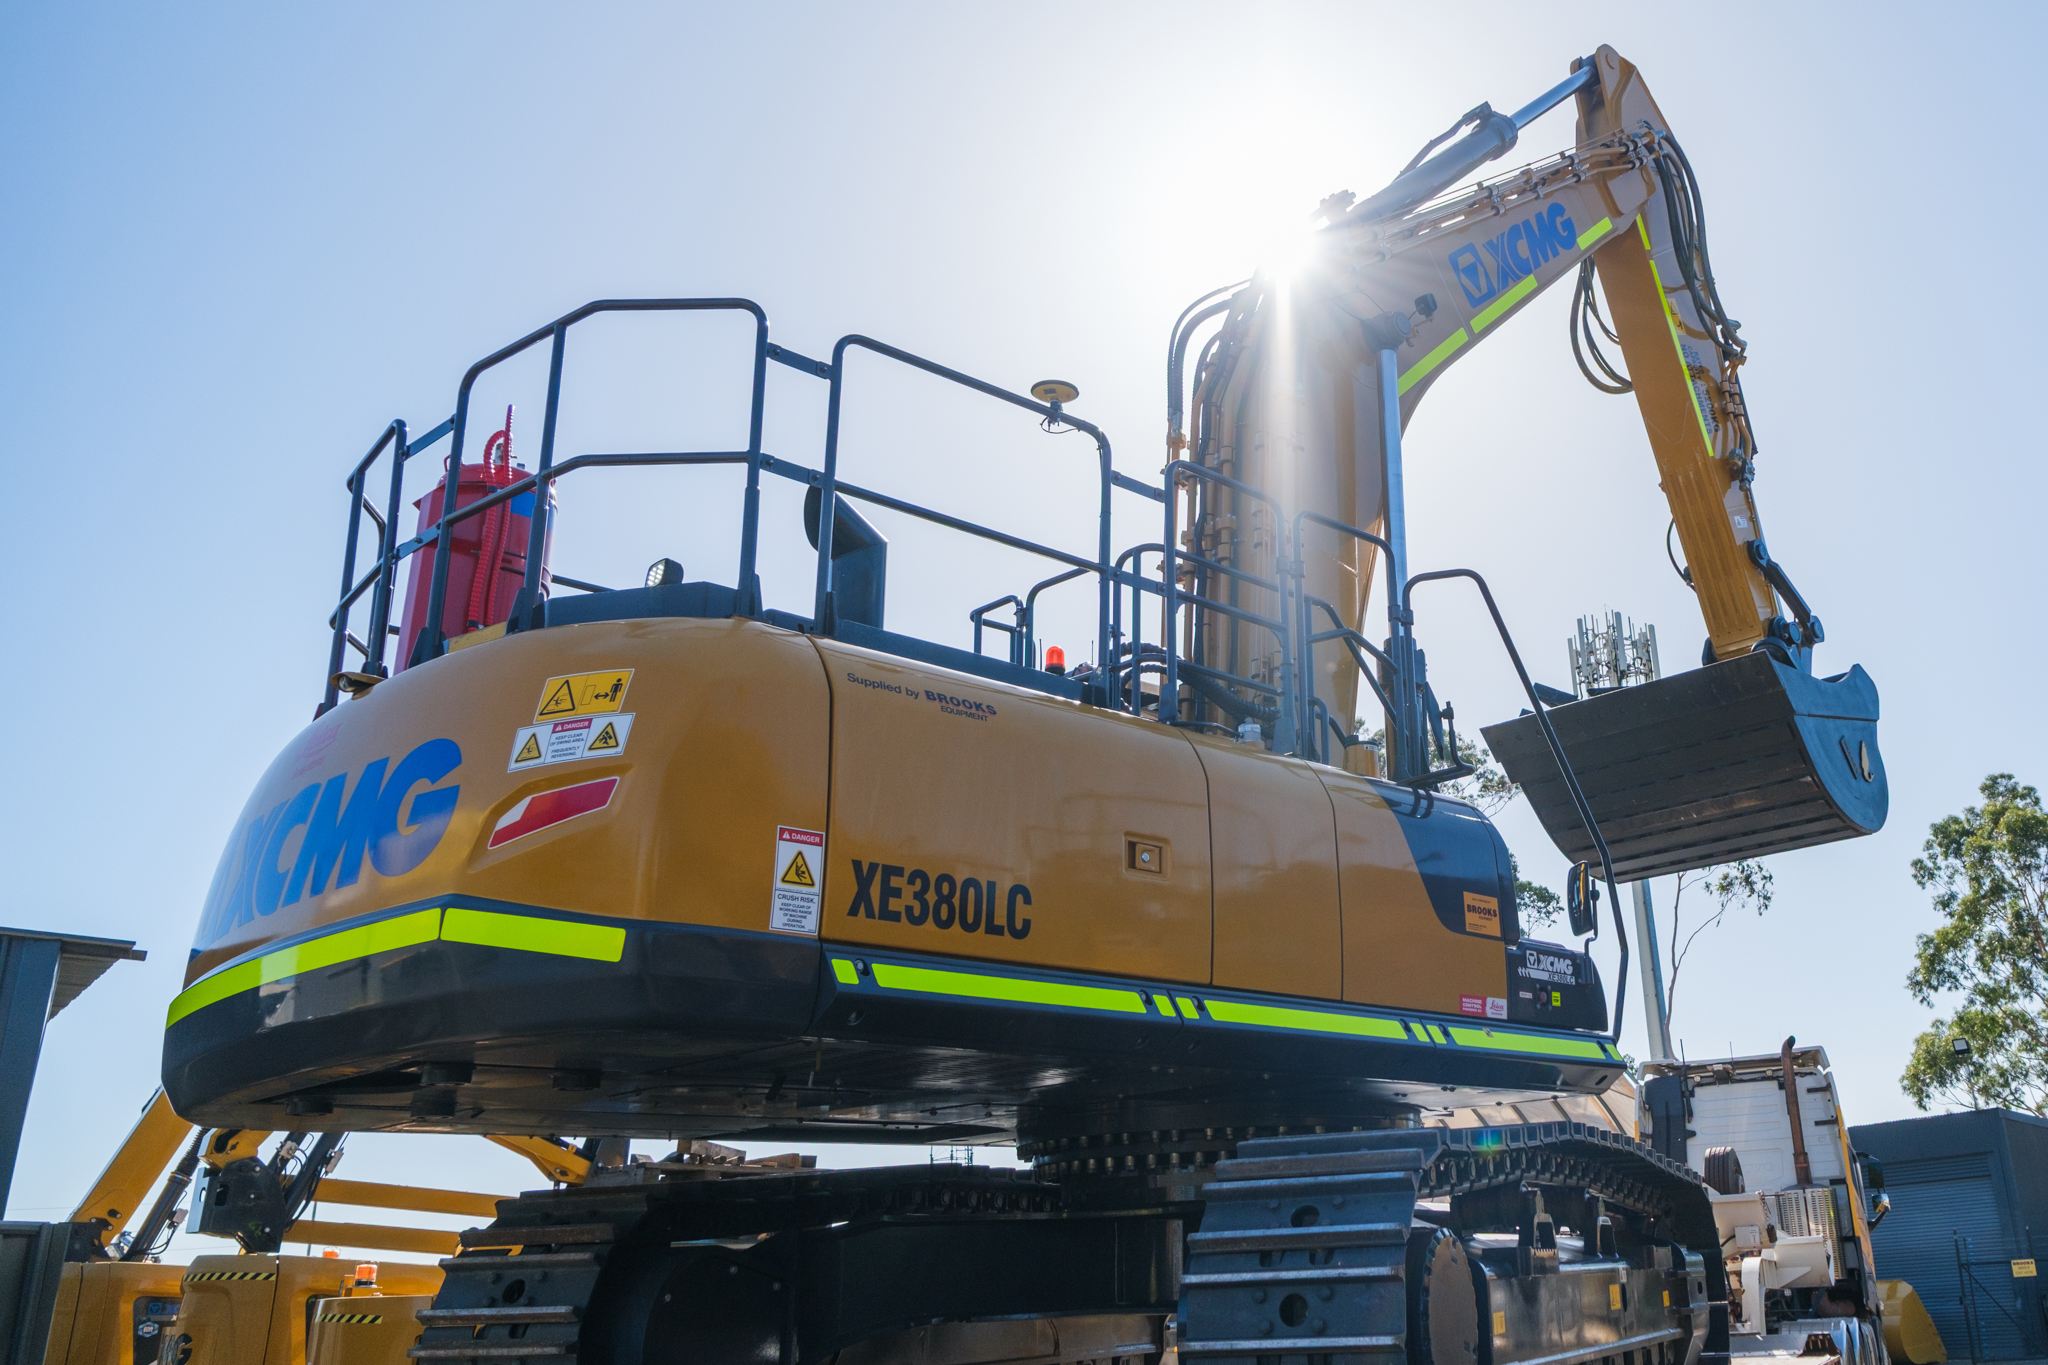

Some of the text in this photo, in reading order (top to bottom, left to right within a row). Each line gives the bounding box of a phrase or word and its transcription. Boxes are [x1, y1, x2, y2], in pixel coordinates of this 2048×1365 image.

[1481, 202, 1577, 294] XCMG
[1681, 344, 1713, 435] NO ATTACHMENTS
[847, 672, 997, 715] Supplied by BROOKS
[940, 705, 989, 722] EQUIPMENT
[563, 721, 589, 730] DANGER
[214, 738, 462, 942] XCMG
[791, 833, 820, 843] DANGER
[777, 893, 799, 902] CRUSH
[846, 858, 1032, 940] XE380LC
[1466, 903, 1498, 918] BROOKS
[1537, 953, 1573, 975] XCMG
